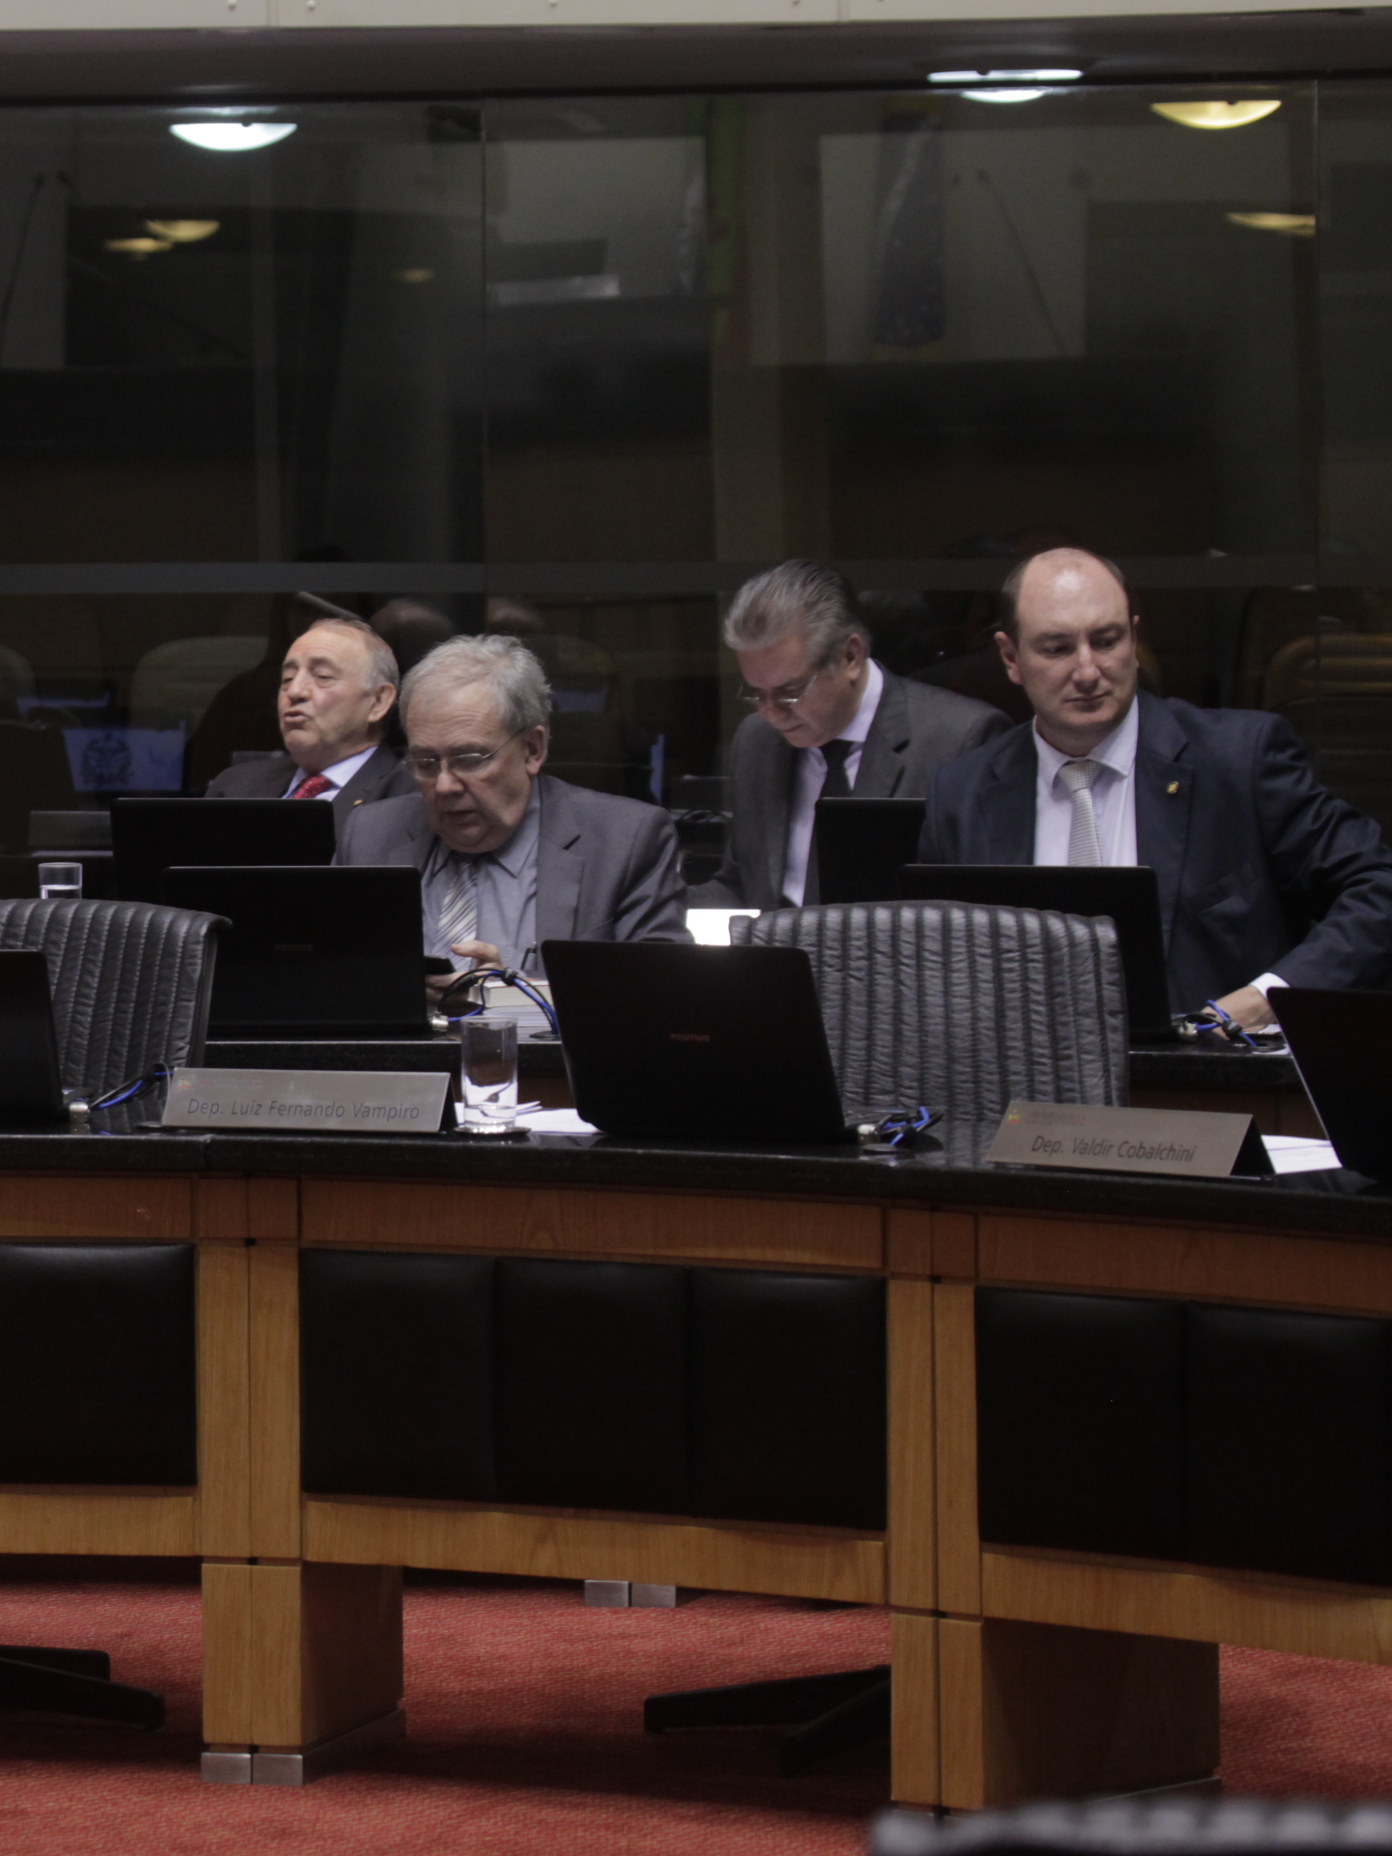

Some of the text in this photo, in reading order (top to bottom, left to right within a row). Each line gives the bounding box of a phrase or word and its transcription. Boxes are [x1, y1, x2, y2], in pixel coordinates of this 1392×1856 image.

[187, 1098, 420, 1122] Dep. Luiz Fernando Vampiro
[1031, 1135, 1197, 1163] Dep. Valdir Cobalchini
